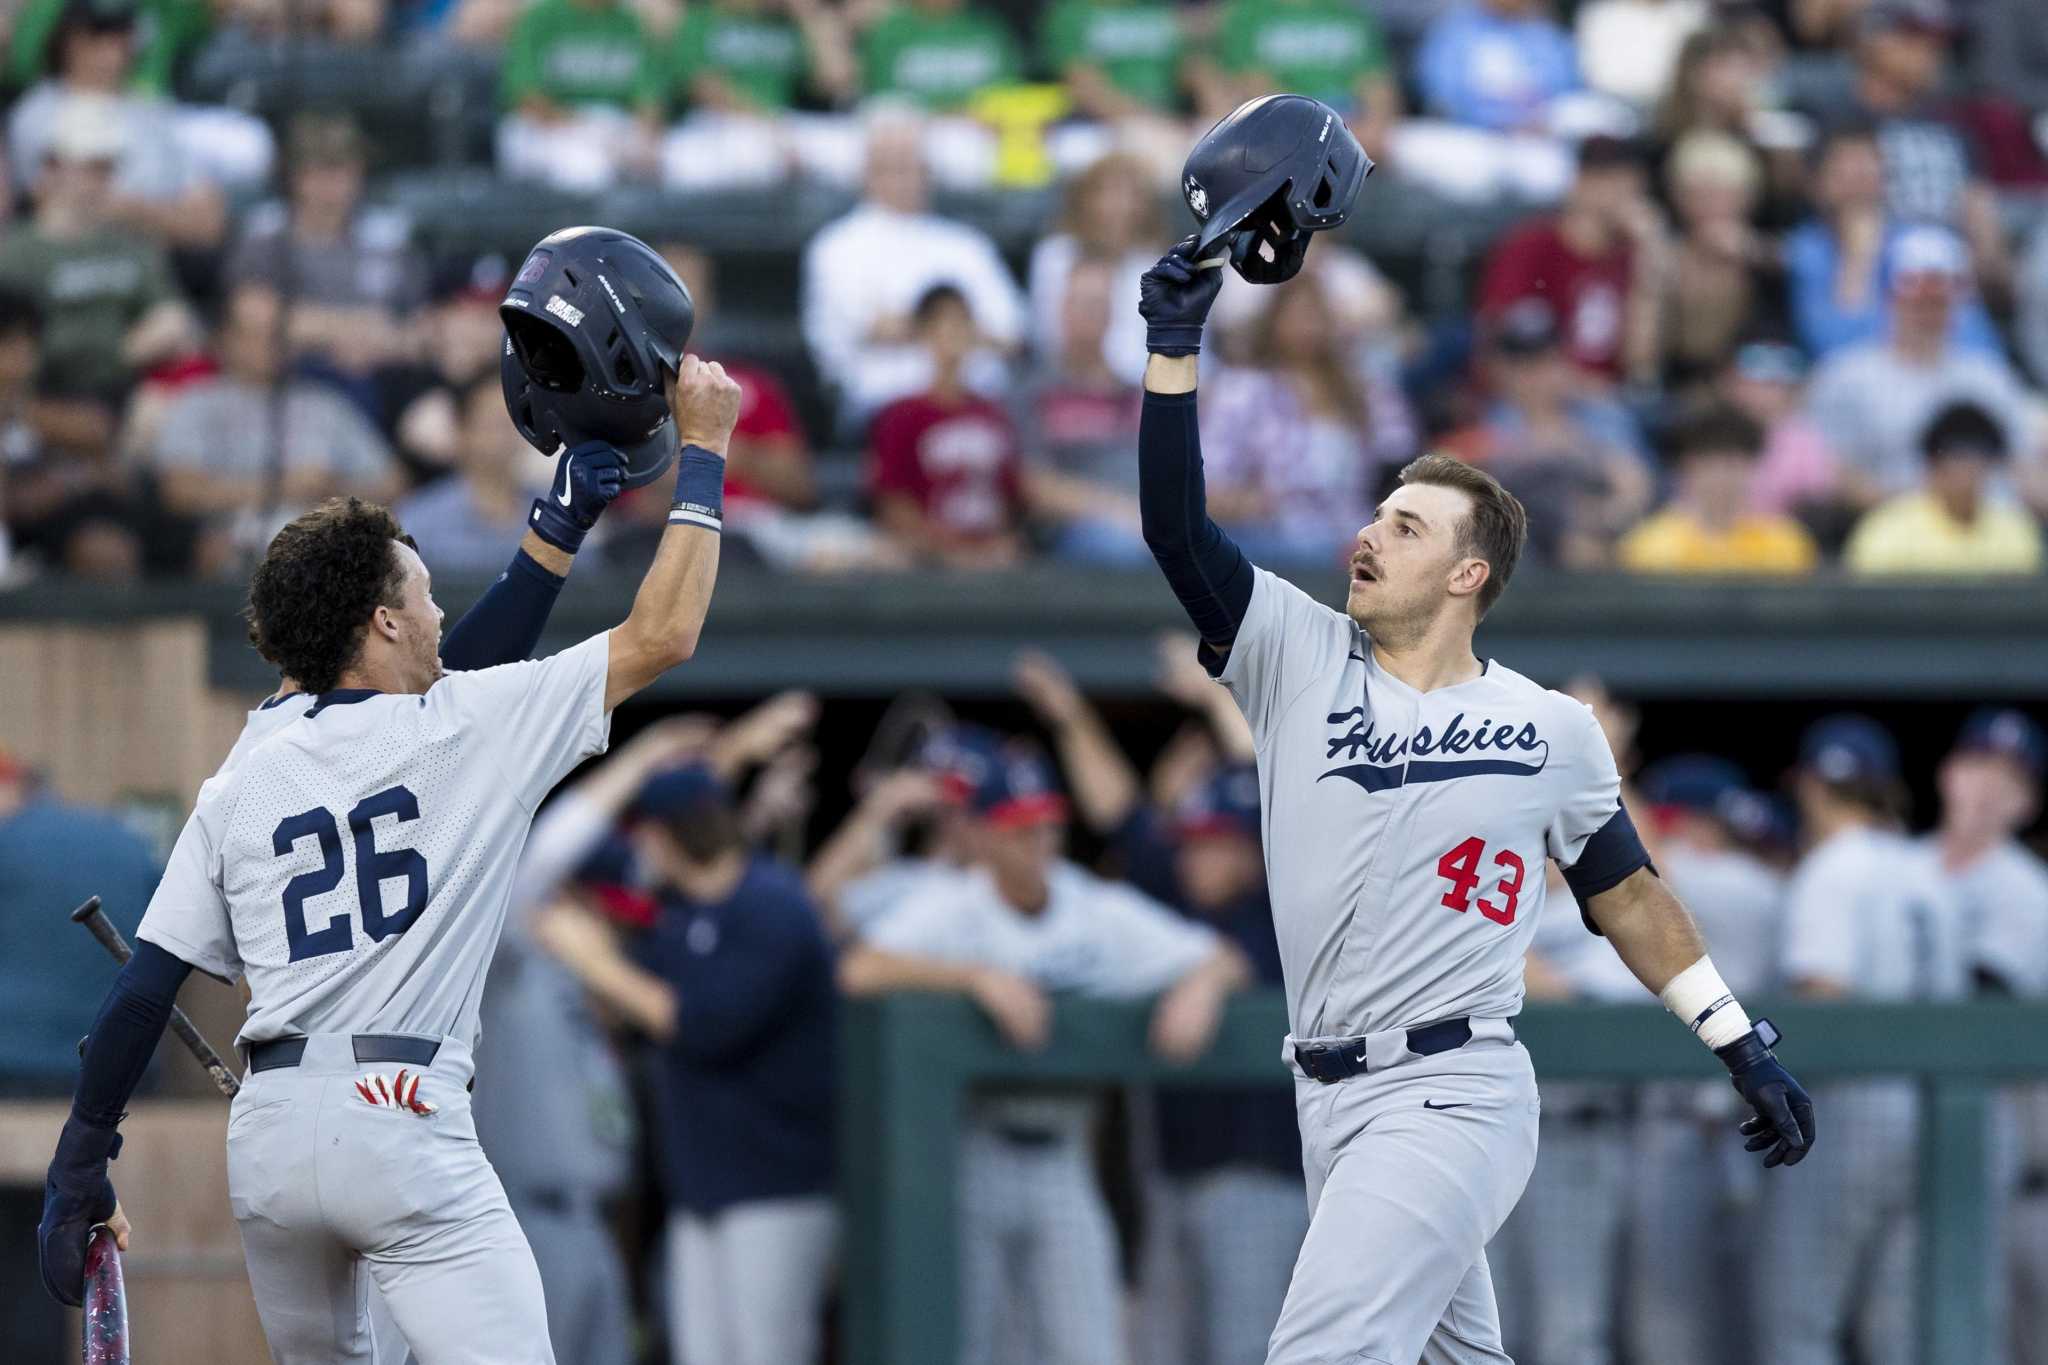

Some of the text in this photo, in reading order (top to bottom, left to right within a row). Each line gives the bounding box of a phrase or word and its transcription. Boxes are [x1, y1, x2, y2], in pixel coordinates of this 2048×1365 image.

[518, 255, 551, 283] 26
[1326, 706, 1542, 764] Huskies
[272, 784, 429, 964] 26
[1437, 836, 1525, 926] 43
